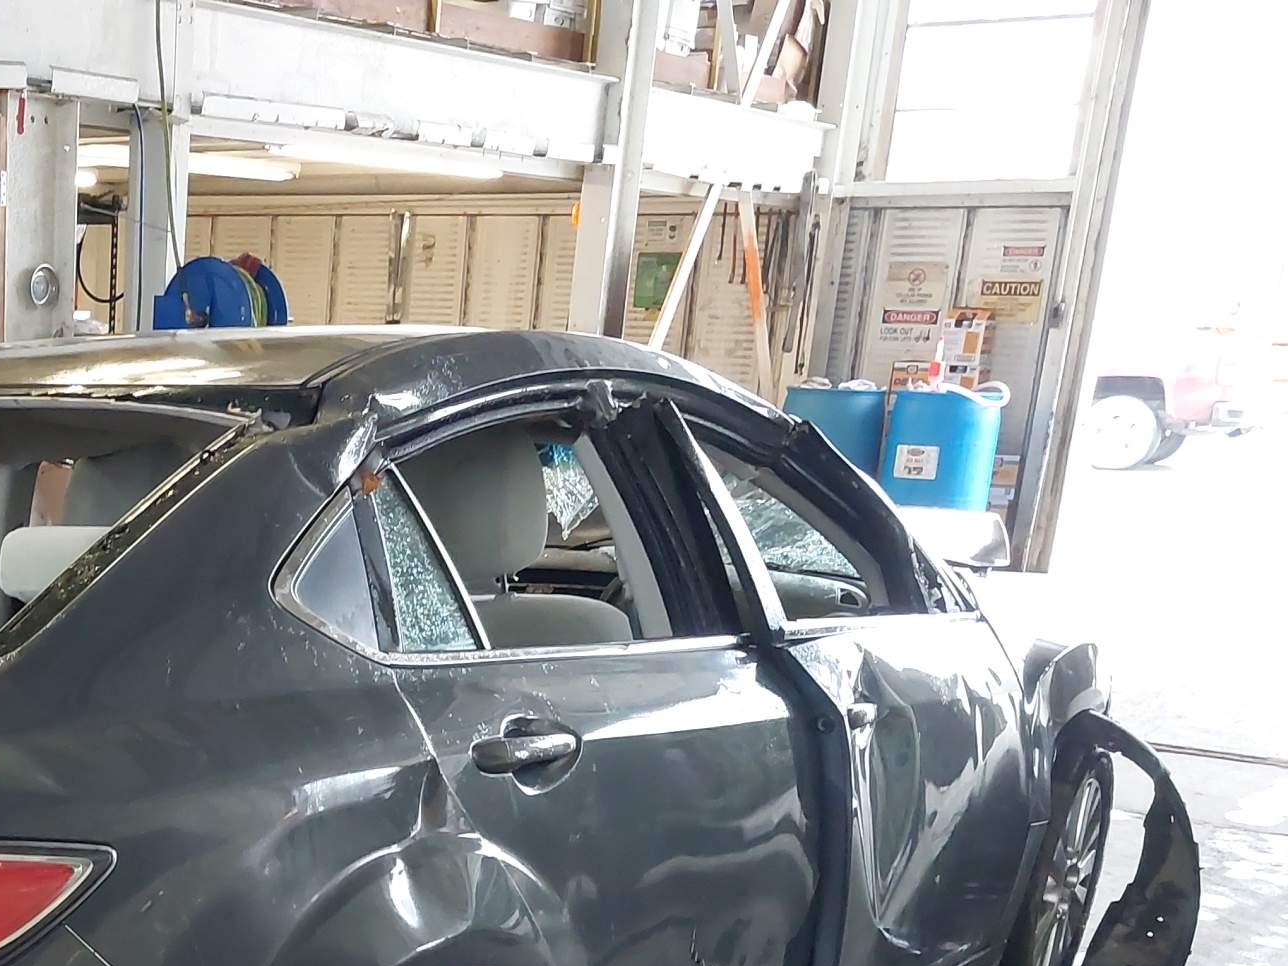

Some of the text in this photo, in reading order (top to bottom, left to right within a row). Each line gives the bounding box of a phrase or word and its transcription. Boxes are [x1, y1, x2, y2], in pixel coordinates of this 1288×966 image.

[983, 282, 1040, 295] CAUTION
[889, 312, 931, 322] DANGER
[899, 327, 914, 336] OUT
